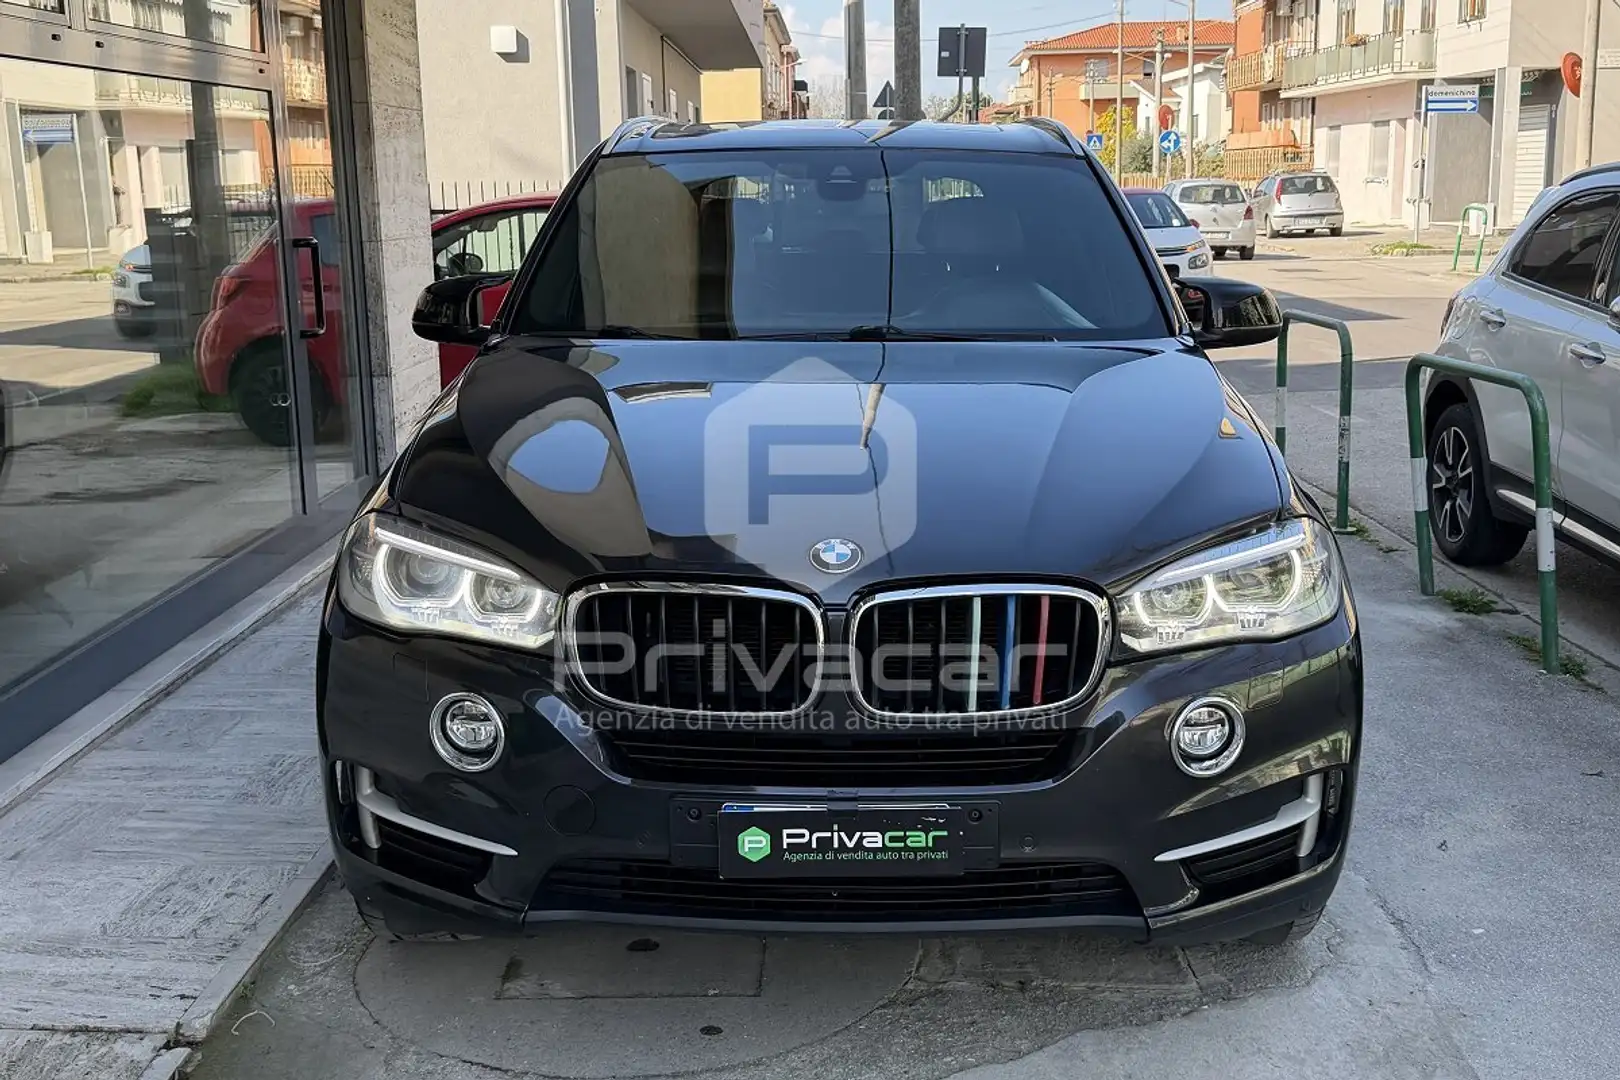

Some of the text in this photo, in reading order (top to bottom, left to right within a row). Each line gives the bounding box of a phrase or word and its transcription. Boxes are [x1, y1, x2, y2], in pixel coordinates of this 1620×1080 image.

[744, 836, 767, 853] P
[782, 823, 949, 849] Privacar
[782, 850, 949, 863] Agenzia di vendita auto tra privati
